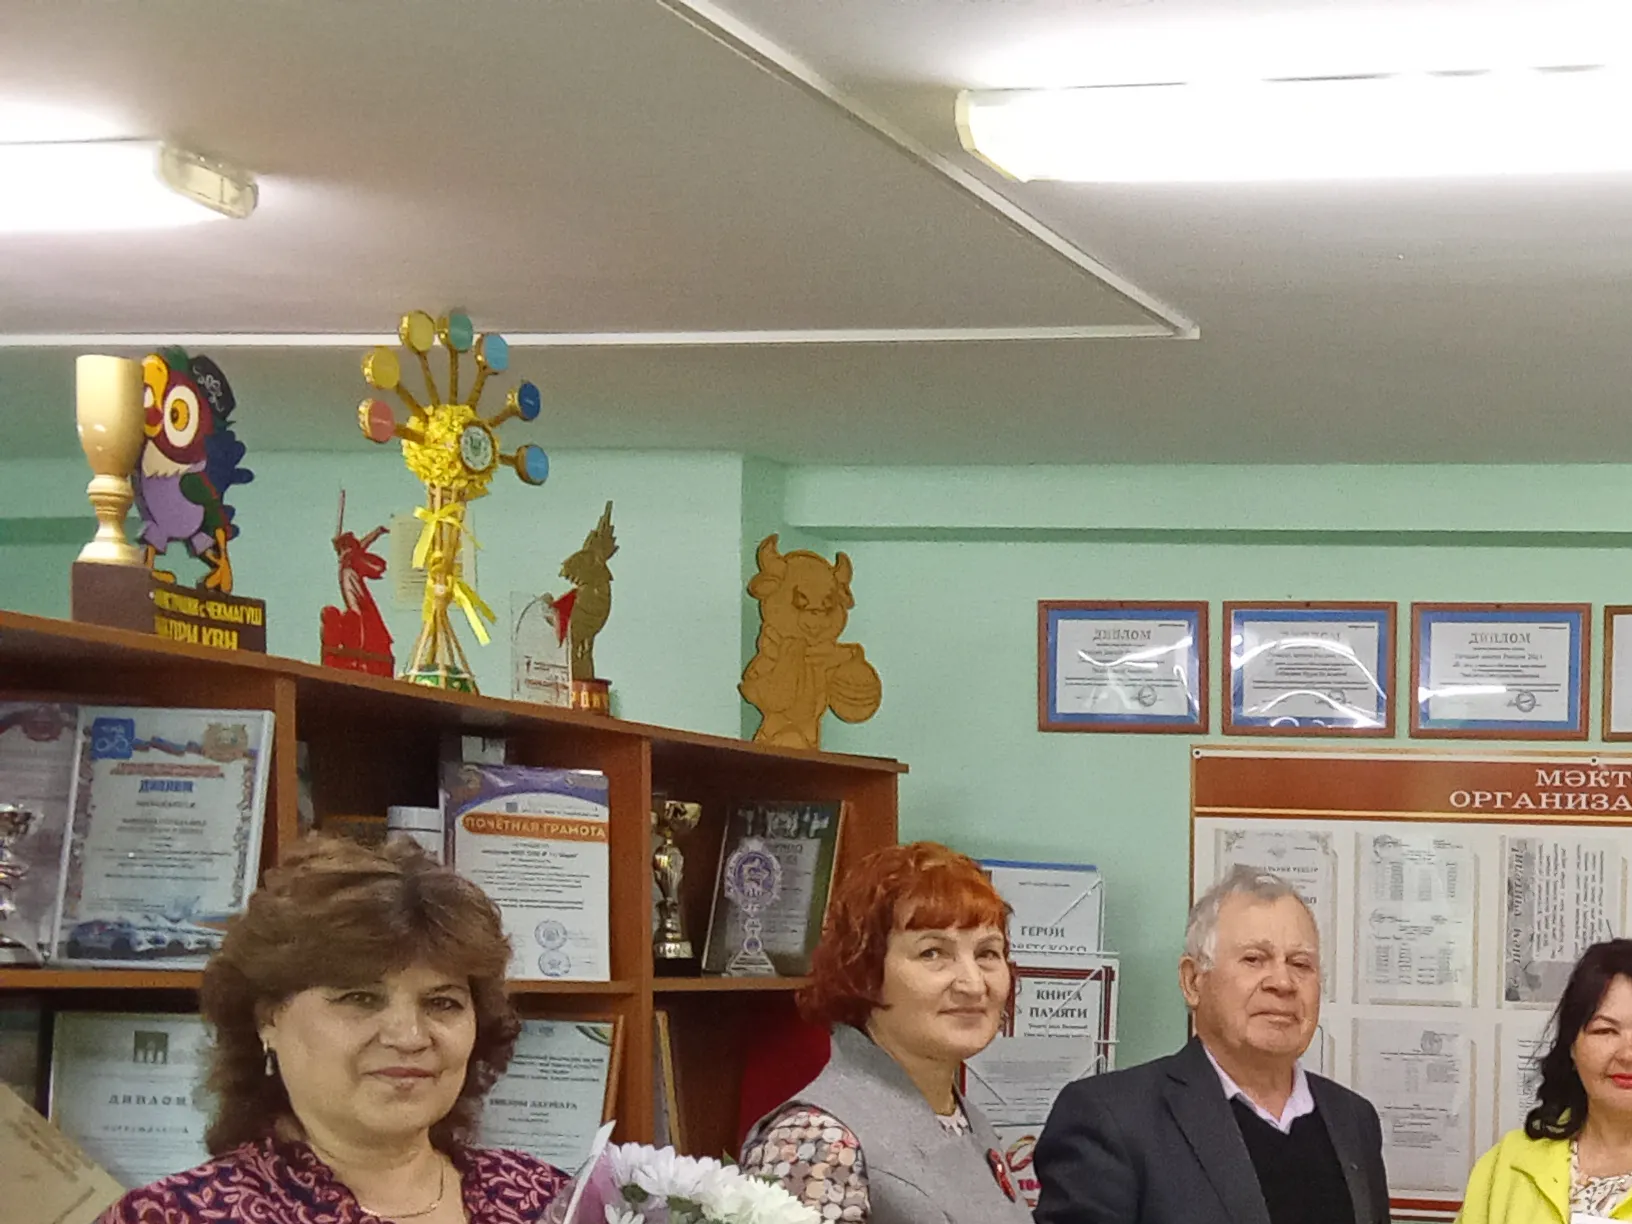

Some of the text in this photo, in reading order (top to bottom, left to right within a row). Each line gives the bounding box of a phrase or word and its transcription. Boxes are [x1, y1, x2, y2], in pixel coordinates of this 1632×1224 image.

[1093, 629, 1151, 641] ДИПЛОМ
[1468, 632, 1531, 644] ДИПЛОМ
[464, 815, 606, 838] ПОЧЁТНАЯ ГРАМОТА
